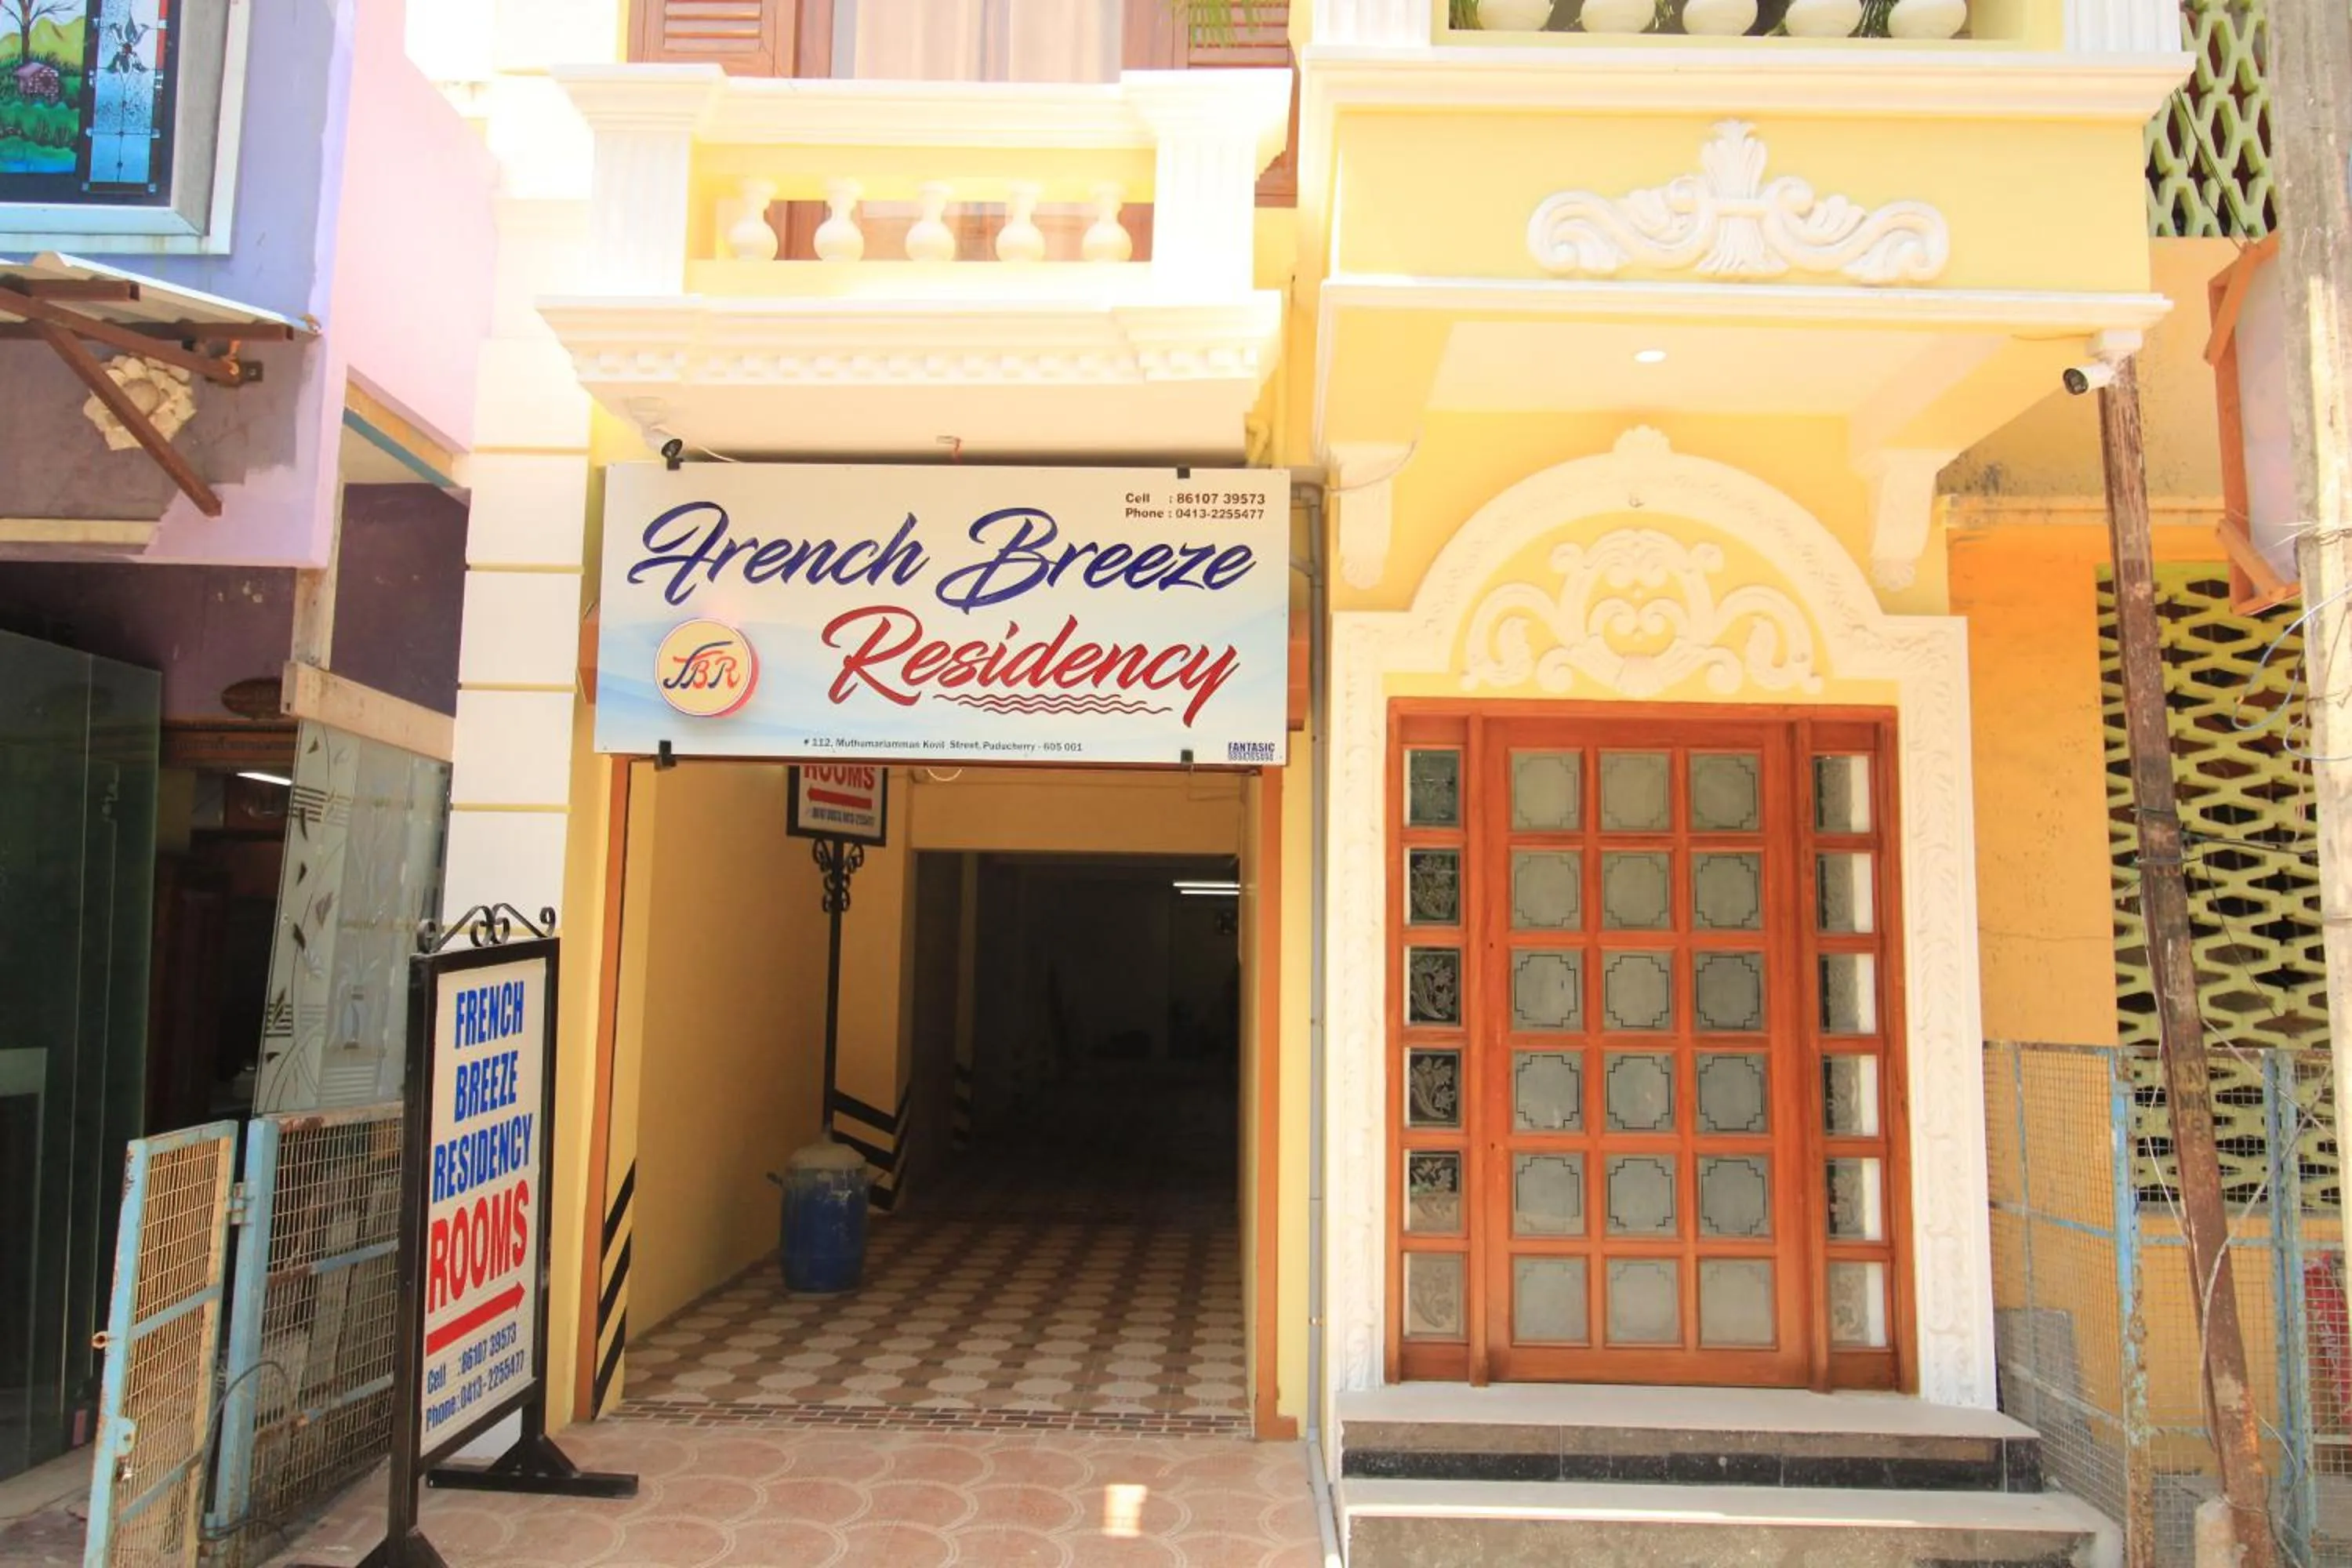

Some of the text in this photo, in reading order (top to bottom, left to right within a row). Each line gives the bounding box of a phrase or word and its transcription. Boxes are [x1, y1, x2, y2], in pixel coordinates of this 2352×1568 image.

[1125, 492, 1150, 503] Cell
[1177, 493, 1218, 504] 86107
[1223, 493, 1265, 505] 39573
[1125, 508, 1164, 518] Phone
[1176, 509, 1264, 519] 0413-2255477
[628, 501, 1256, 615] French Breeze
[821, 604, 1240, 728] Residency
[455, 980, 524, 1049] FRENCH
[455, 1050, 518, 1123] BREEZE
[433, 1112, 533, 1204] RESIDENCY
[428, 1178, 529, 1314] ROOMS
[427, 1362, 446, 1395] Cell
